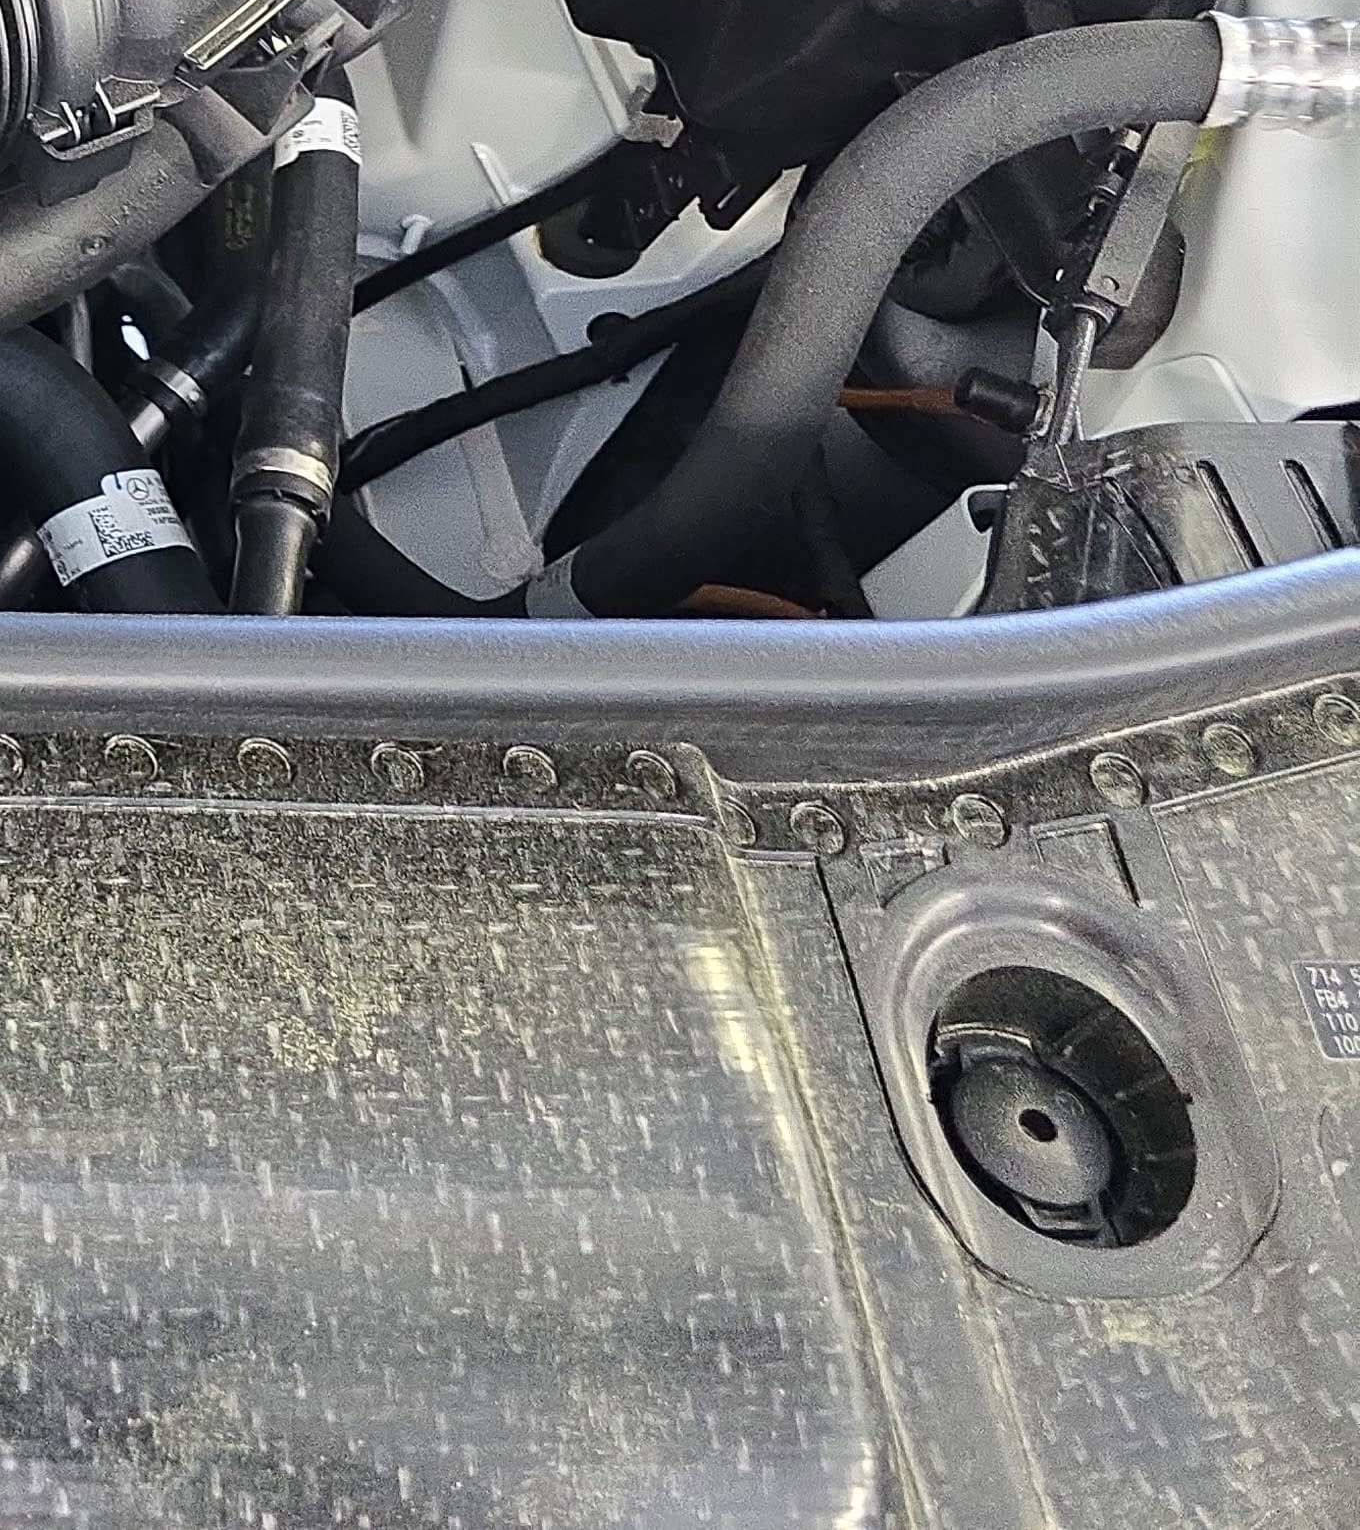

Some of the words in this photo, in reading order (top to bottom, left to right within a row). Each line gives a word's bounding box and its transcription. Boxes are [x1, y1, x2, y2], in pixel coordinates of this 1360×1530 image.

[1305, 966, 1343, 986] 714
[1314, 989, 1349, 1009] FB4
[1321, 1012, 1359, 1032] 110
